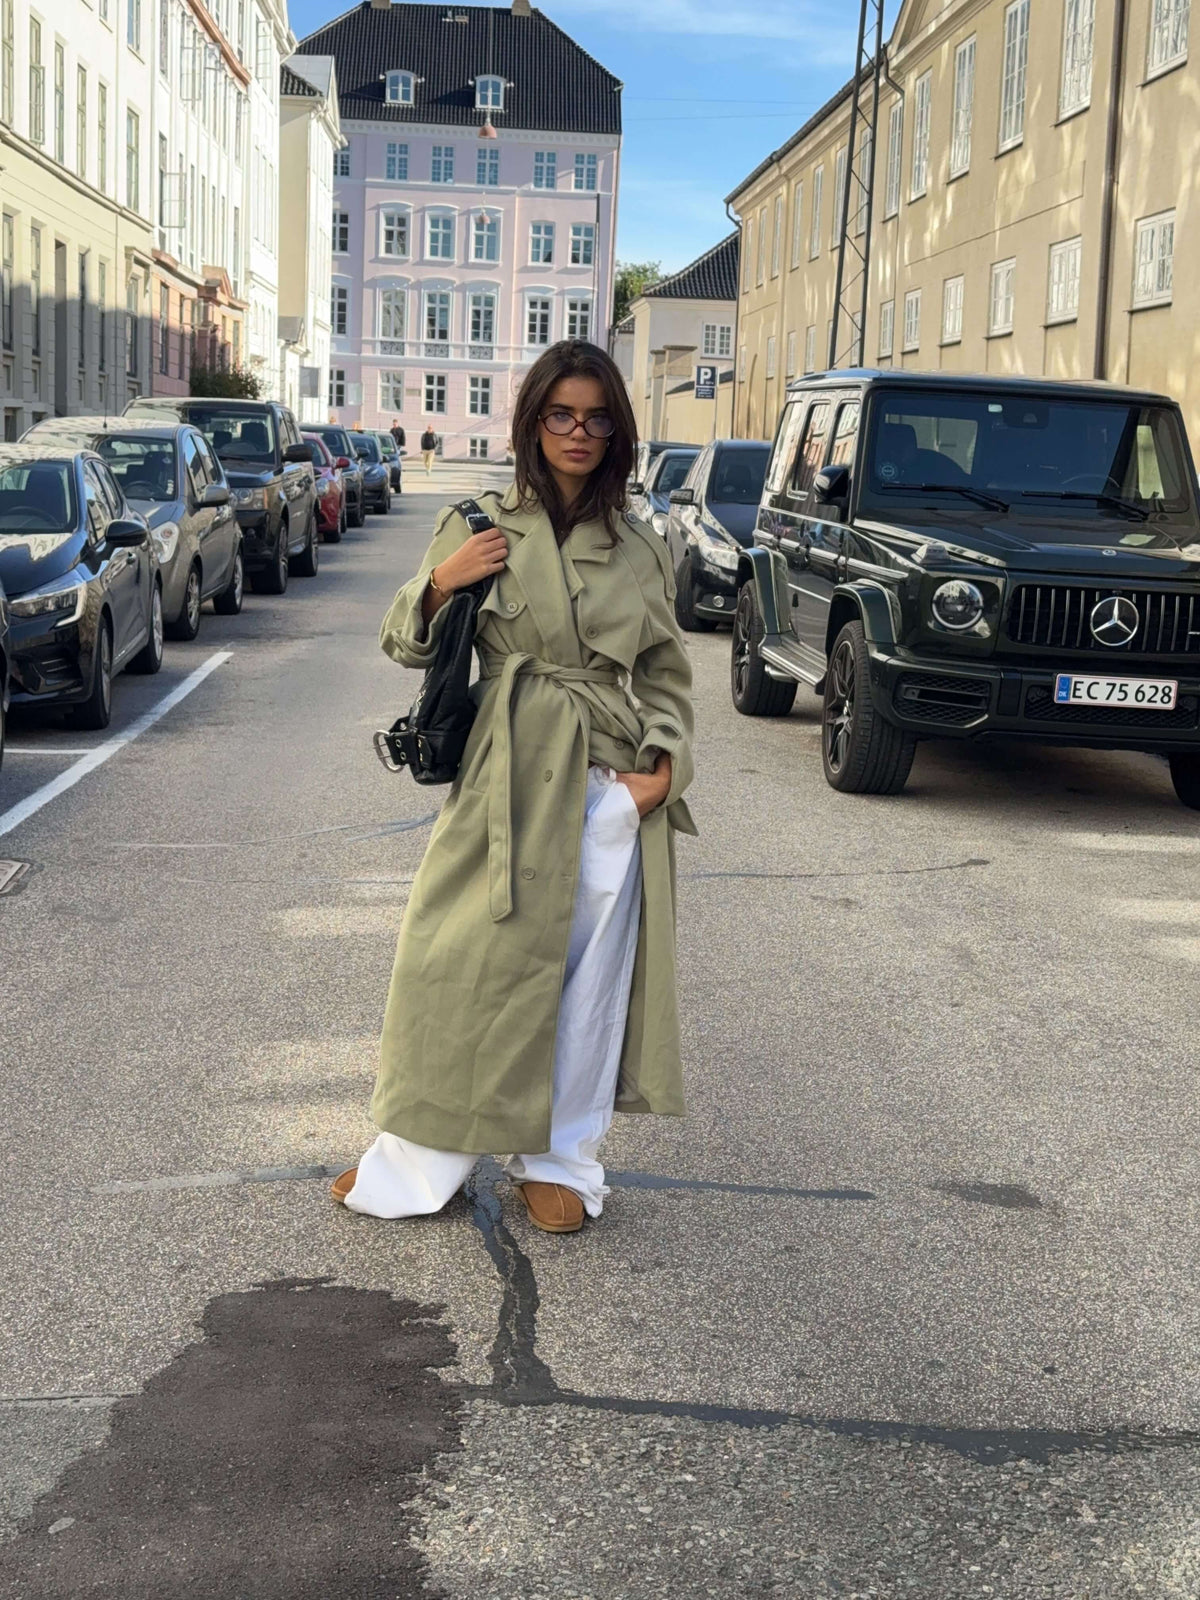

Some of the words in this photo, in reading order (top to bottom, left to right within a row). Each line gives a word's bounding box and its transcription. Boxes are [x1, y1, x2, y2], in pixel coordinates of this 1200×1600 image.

[700, 367, 712, 385] P
[1072, 680, 1100, 700] EC
[1105, 682, 1129, 702] 75
[1134, 684, 1172, 704] 628
